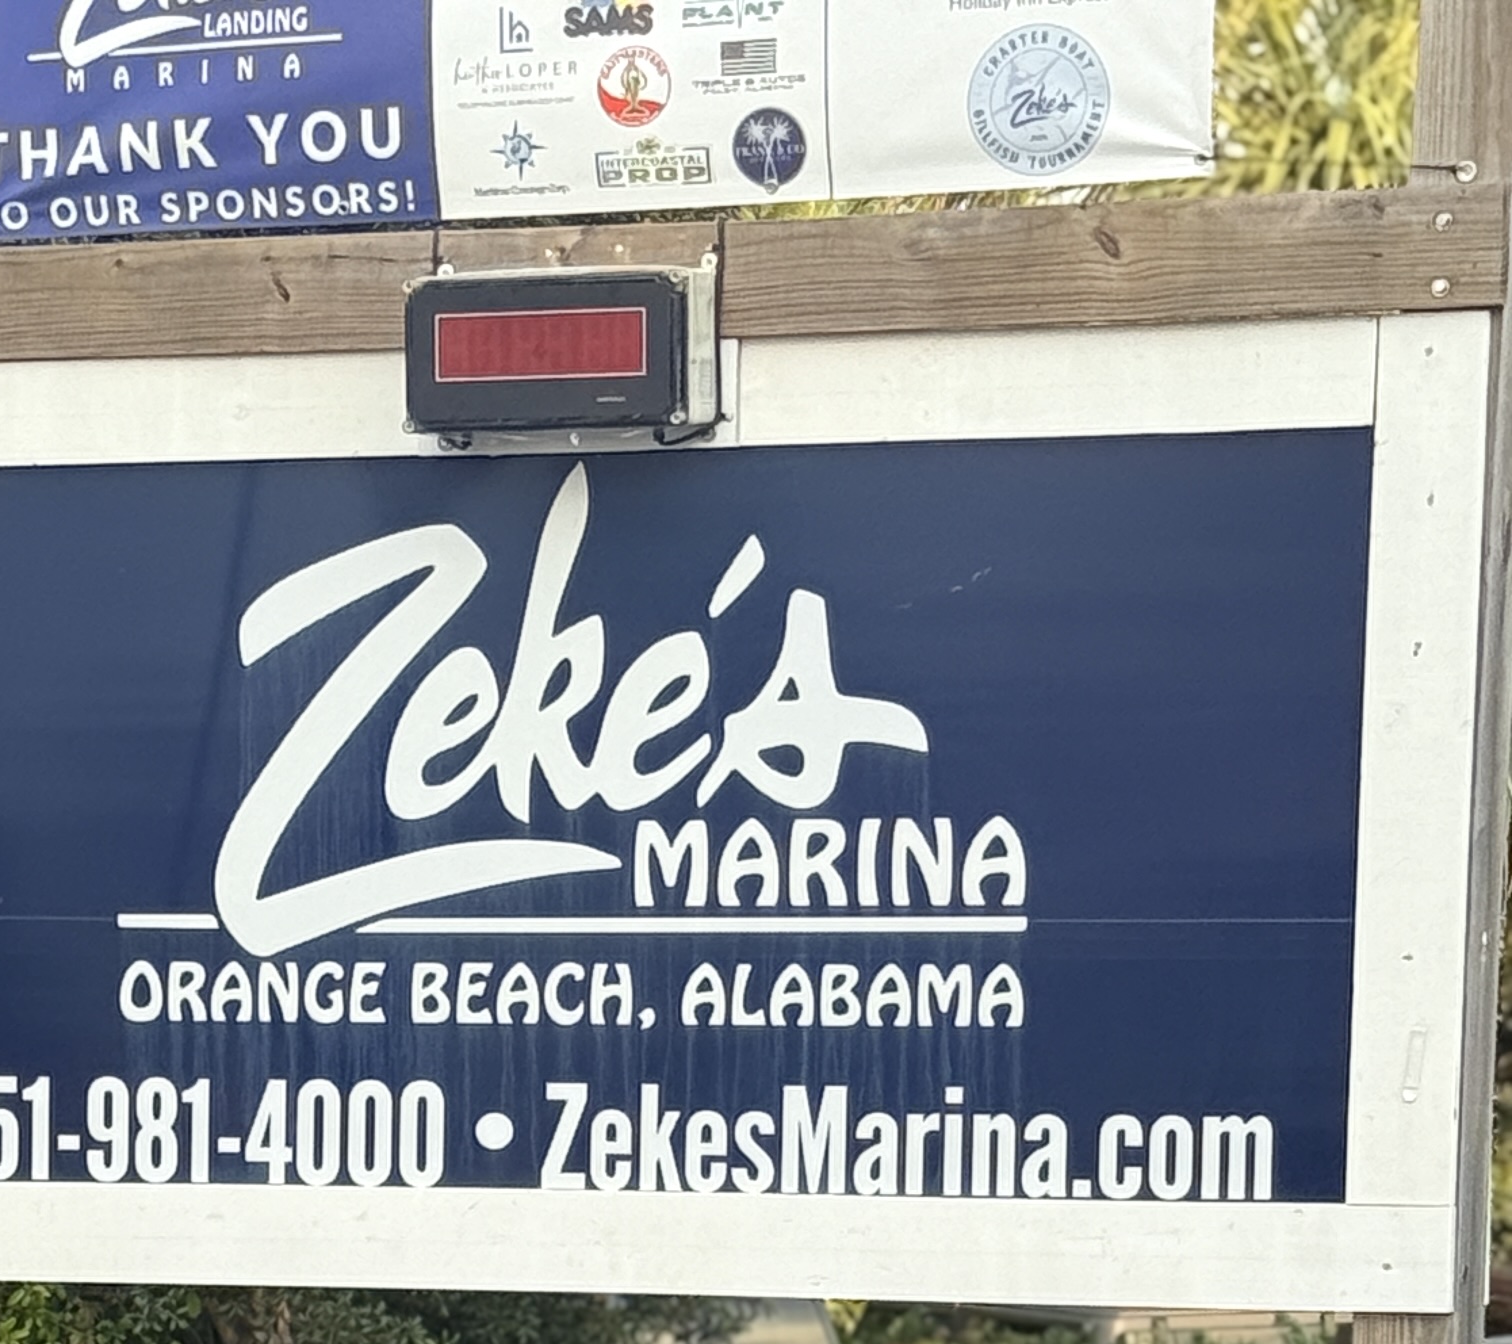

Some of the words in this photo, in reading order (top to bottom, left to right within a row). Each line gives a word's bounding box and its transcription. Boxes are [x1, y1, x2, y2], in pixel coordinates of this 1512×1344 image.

[203, 6, 309, 38] LANDING
[563, 3, 655, 38] SAMS
[65, 53, 302, 94] MARINA
[506, 60, 577, 78] LOPER
[246, 107, 401, 165] YOU
[602, 166, 706, 184] PROP
[49, 193, 141, 228] OUR
[161, 179, 415, 223] SPONSORS!
[215, 463, 929, 958] Zeke's
[634, 815, 1028, 908] MARINA
[119, 959, 387, 1024] ORANGE
[411, 961, 657, 1031] BEACH,
[681, 962, 1024, 1028] ALABAMA
[540, 1082, 1273, 1201] ZekesMarina.com
